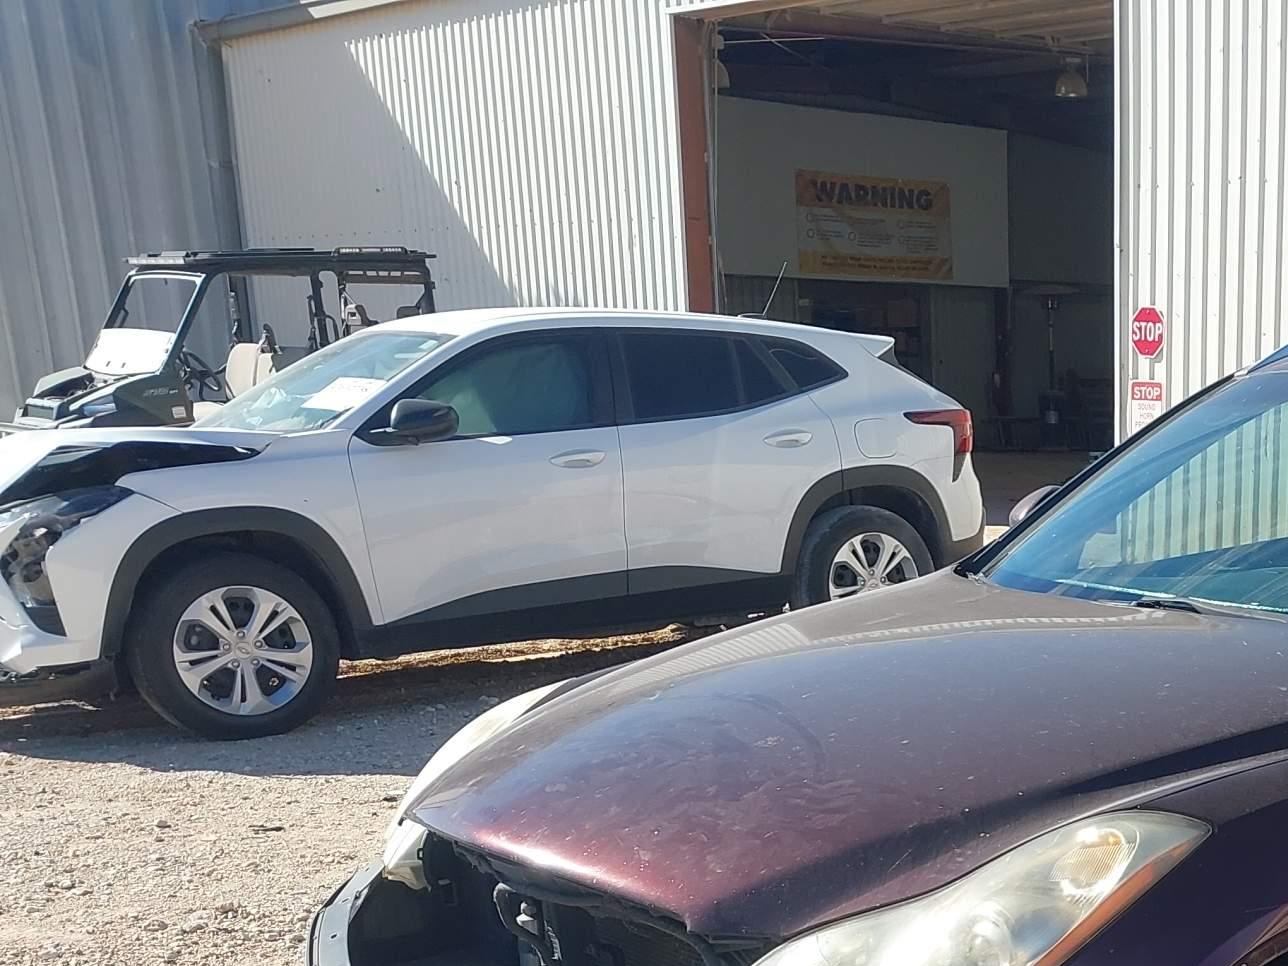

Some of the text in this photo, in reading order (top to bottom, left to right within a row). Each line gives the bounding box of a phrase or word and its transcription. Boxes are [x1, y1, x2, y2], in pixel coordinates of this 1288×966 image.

[814, 180, 933, 210] WARNING
[1132, 321, 1163, 342] STOP
[1133, 386, 1161, 400] STOP
